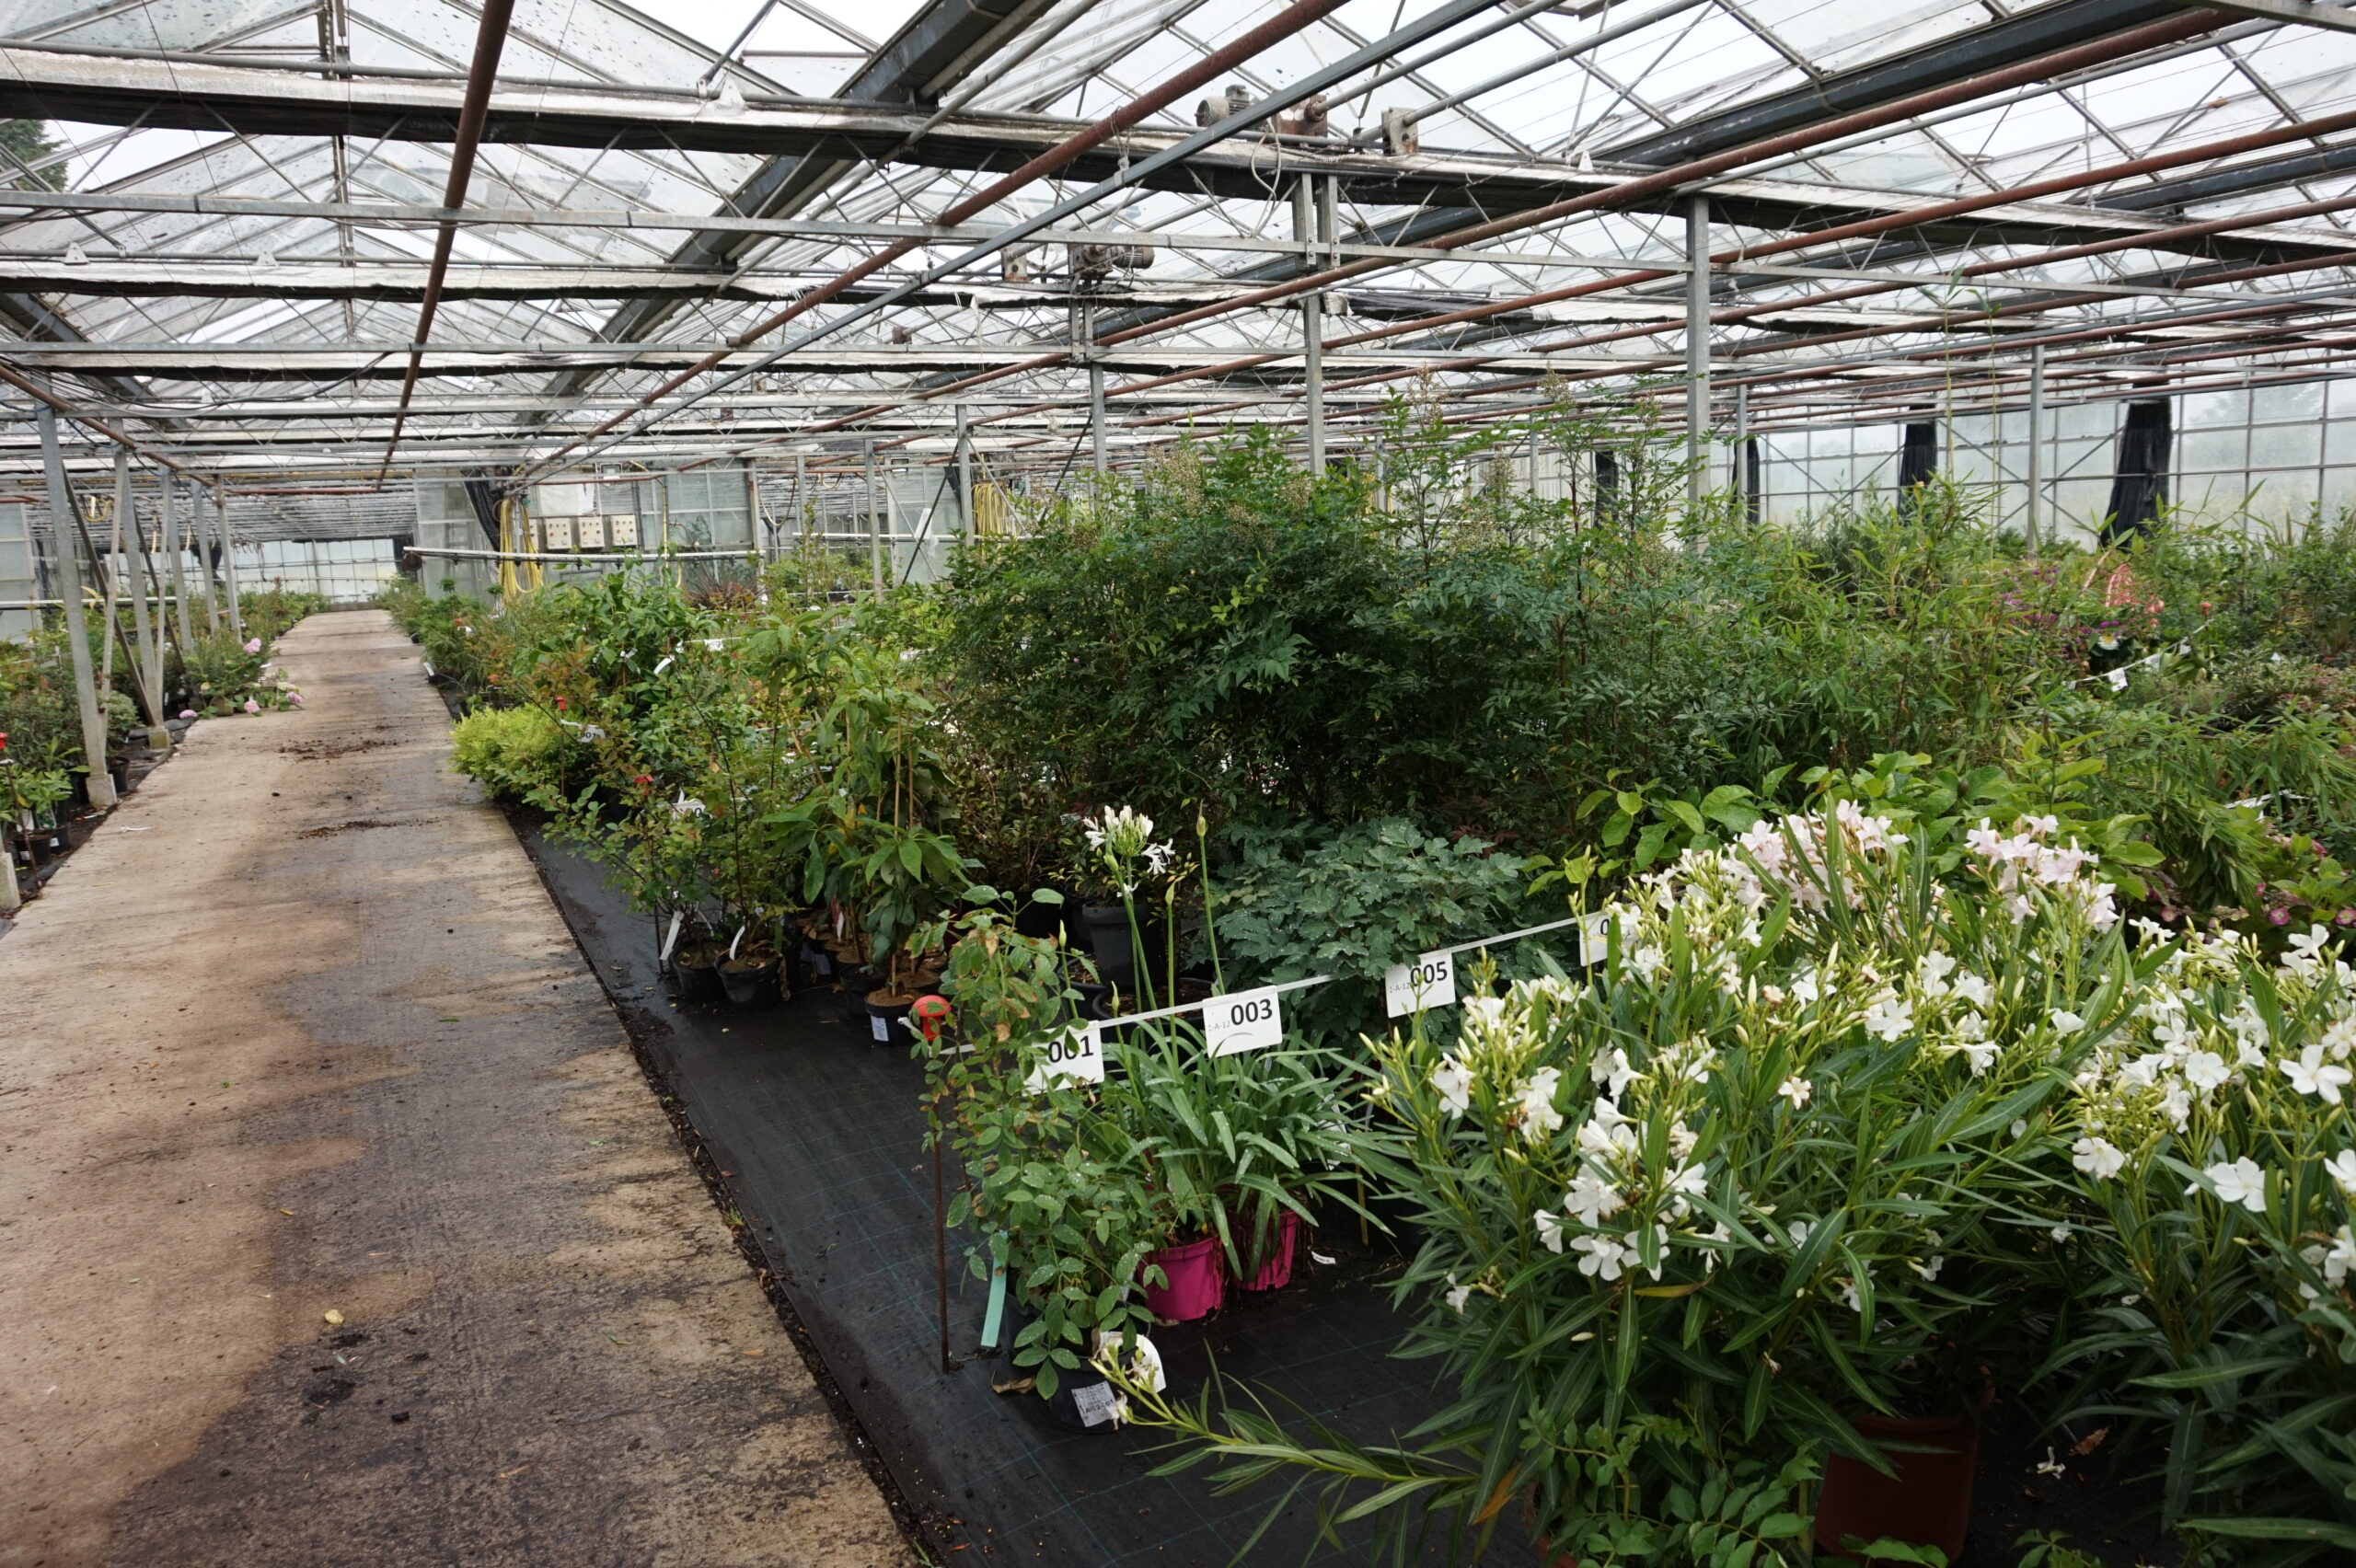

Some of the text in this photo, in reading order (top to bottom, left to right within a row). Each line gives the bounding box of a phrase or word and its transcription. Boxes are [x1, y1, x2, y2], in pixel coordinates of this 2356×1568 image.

[1410, 961, 1448, 986] 005
[1230, 998, 1273, 1026] 003
[1047, 1035, 1094, 1063] 001
